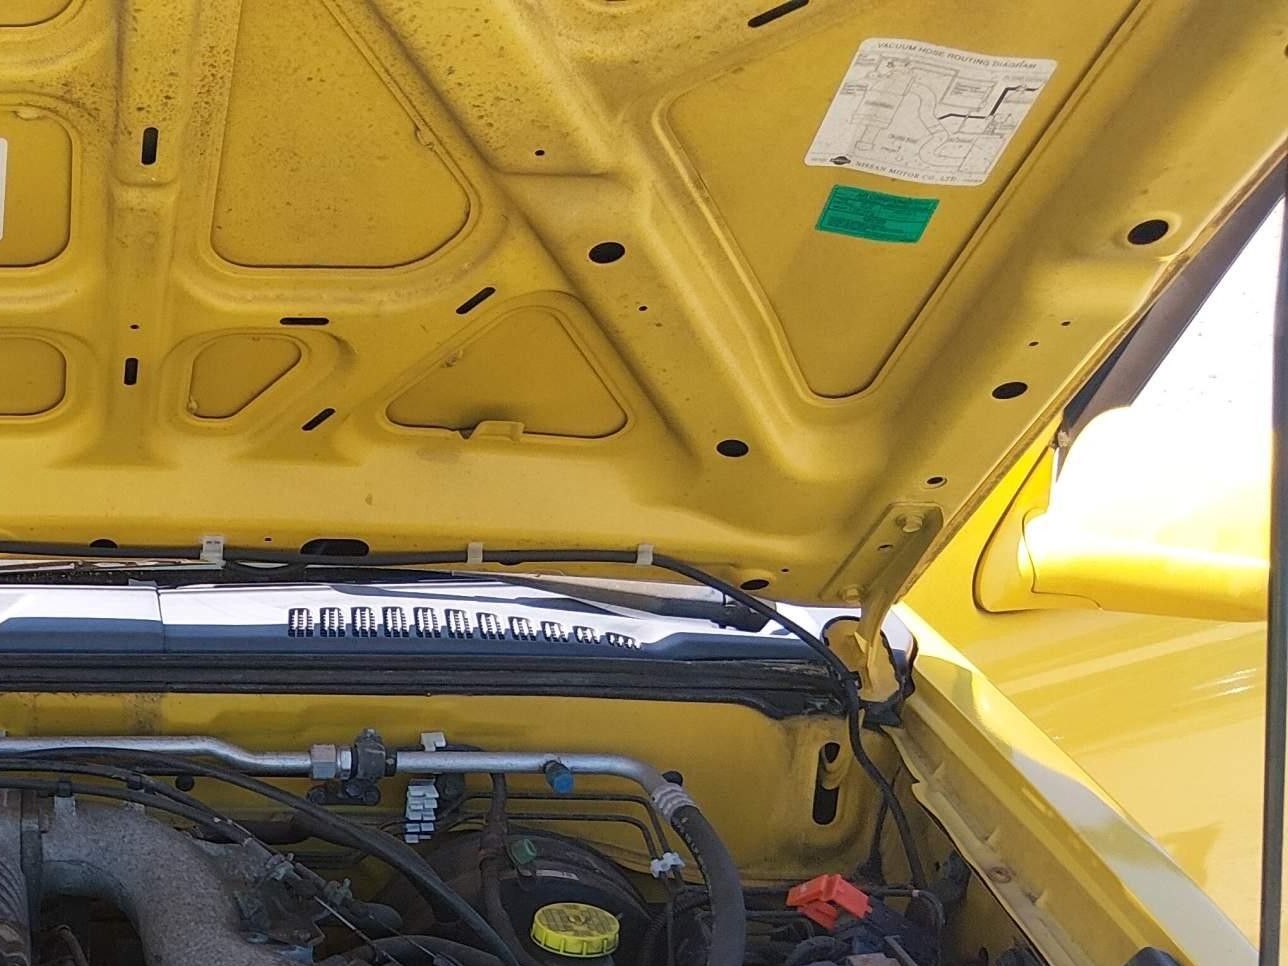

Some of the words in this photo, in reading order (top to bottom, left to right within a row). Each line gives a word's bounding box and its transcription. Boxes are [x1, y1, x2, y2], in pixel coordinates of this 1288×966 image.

[878, 42, 917, 51] VACUUM
[918, 47, 945, 57] HOSE
[947, 52, 989, 67] ROUTING
[855, 160, 887, 172] NISSAN
[889, 168, 920, 179] MOTOR
